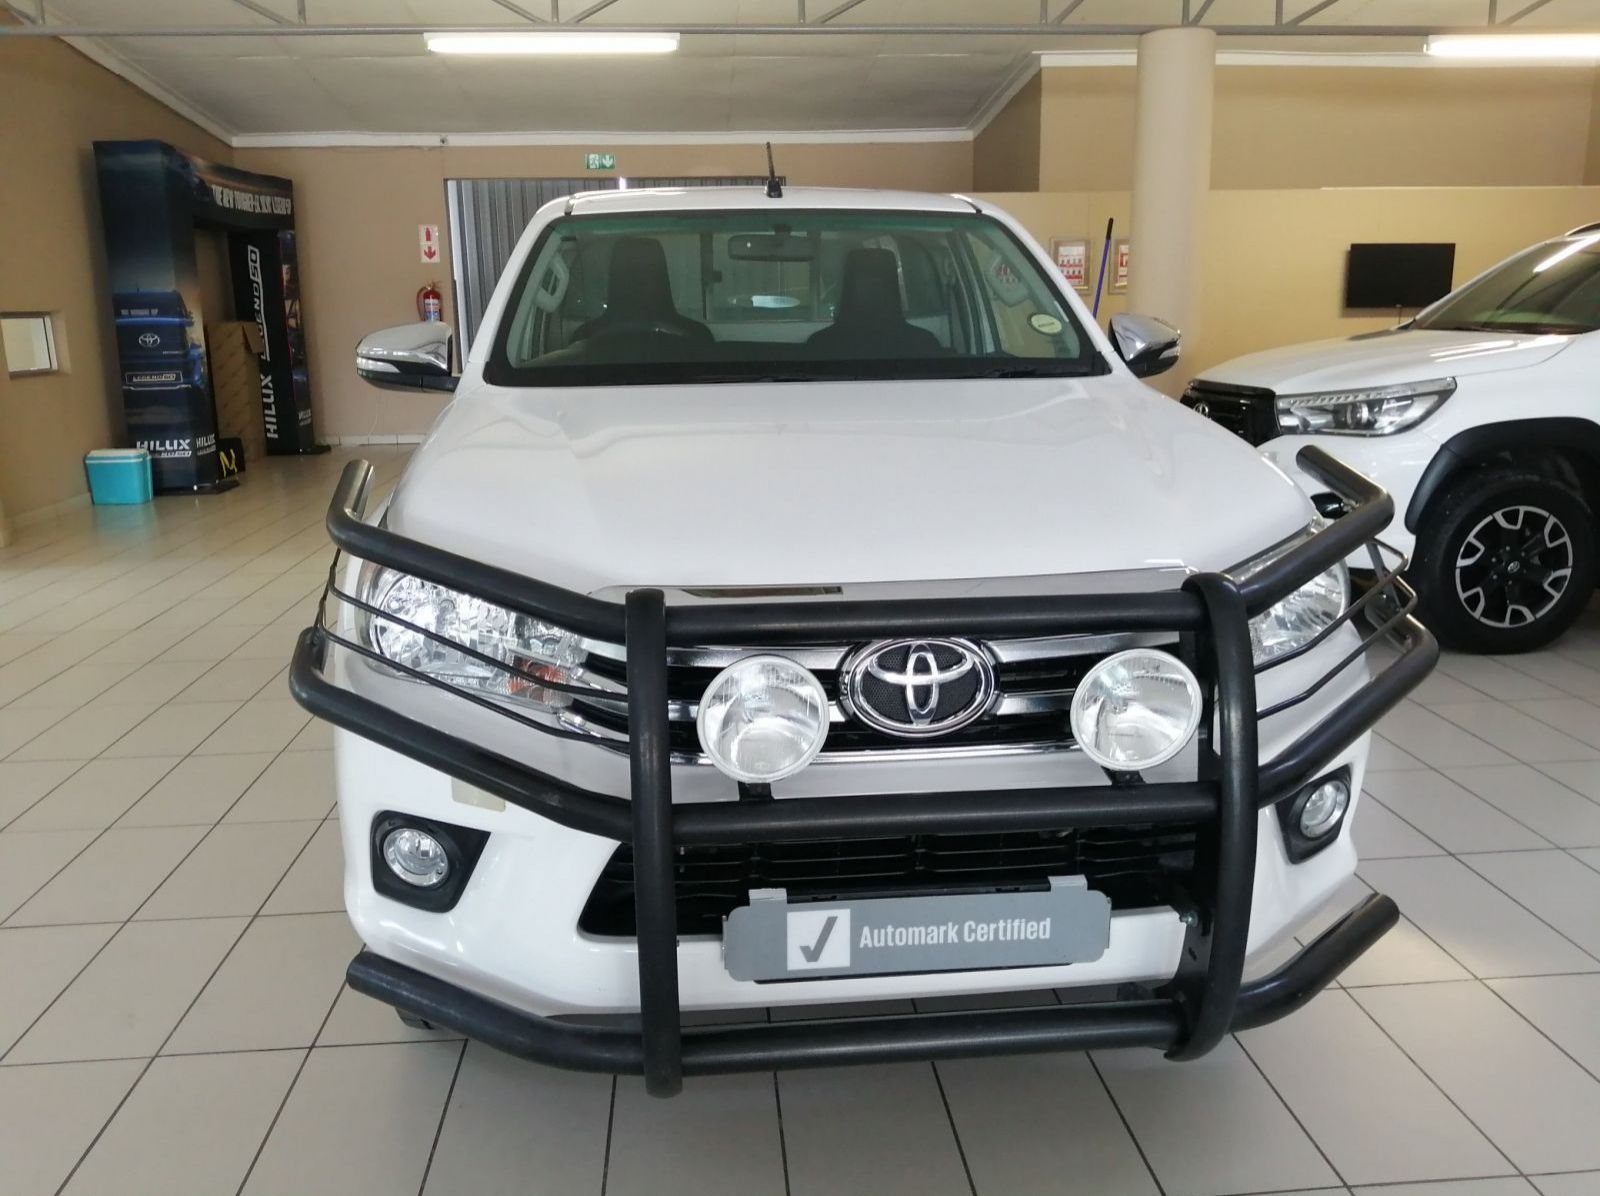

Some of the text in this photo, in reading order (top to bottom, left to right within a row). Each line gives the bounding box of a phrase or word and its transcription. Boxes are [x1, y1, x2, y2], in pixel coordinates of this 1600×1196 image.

[260, 373, 279, 439] HILUX
[136, 439, 191, 451] HILUX
[859, 917, 1052, 949] Automark Certified
